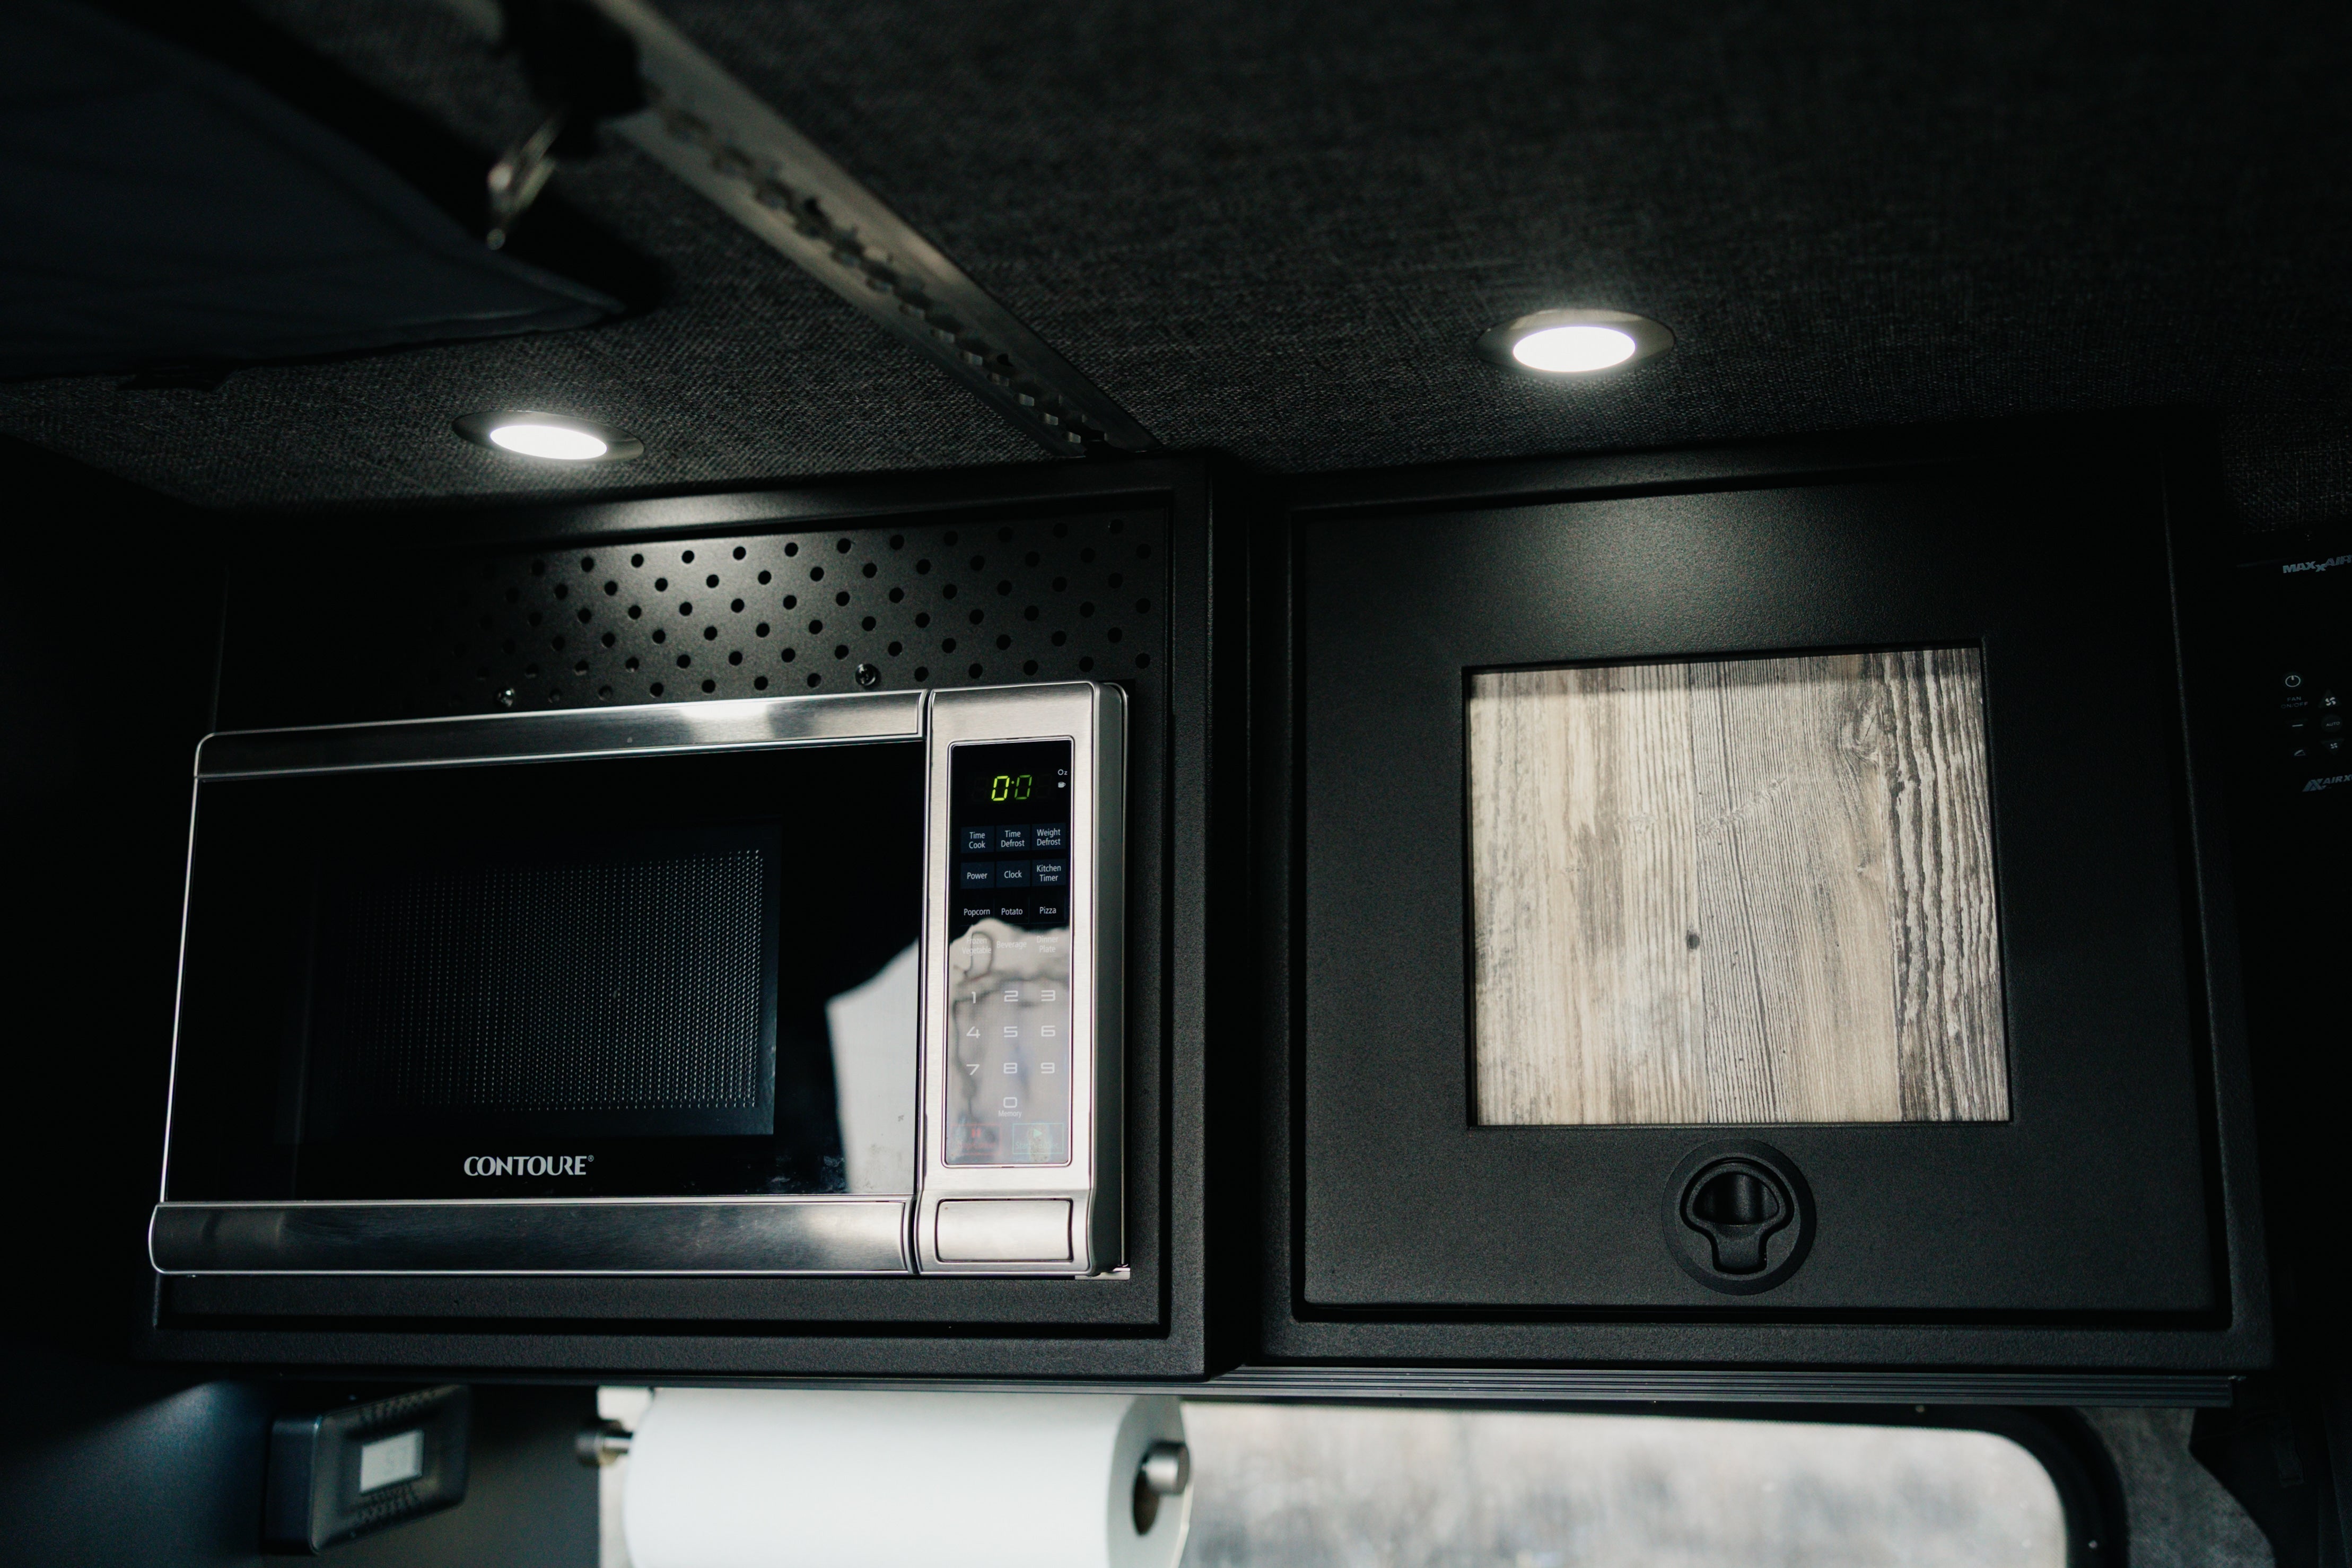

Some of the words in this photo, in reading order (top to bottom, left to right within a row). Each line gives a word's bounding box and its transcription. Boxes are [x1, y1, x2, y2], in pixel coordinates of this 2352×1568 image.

[1037, 828, 1061, 838] Weight
[1001, 839, 1025, 848] Defrost
[1037, 838, 1061, 846] Defrost
[1037, 864, 1061, 872] Kitchen
[964, 908, 991, 917] Popcorn
[996, 941, 1027, 949] Beverage
[962, 946, 992, 956] Vegetable
[971, 991, 976, 1004] 1
[1004, 990, 1018, 1002] 2
[1041, 989, 1055, 1002] 3
[966, 1026, 981, 1038] 4
[1004, 1026, 1018, 1038] 5
[1041, 1025, 1055, 1037] 6
[966, 1064, 980, 1075] 7
[1004, 1063, 1018, 1074] 8
[1041, 1062, 1055, 1074] 9
[1003, 1097, 1018, 1108] 0
[998, 1110, 1022, 1118] Memory
